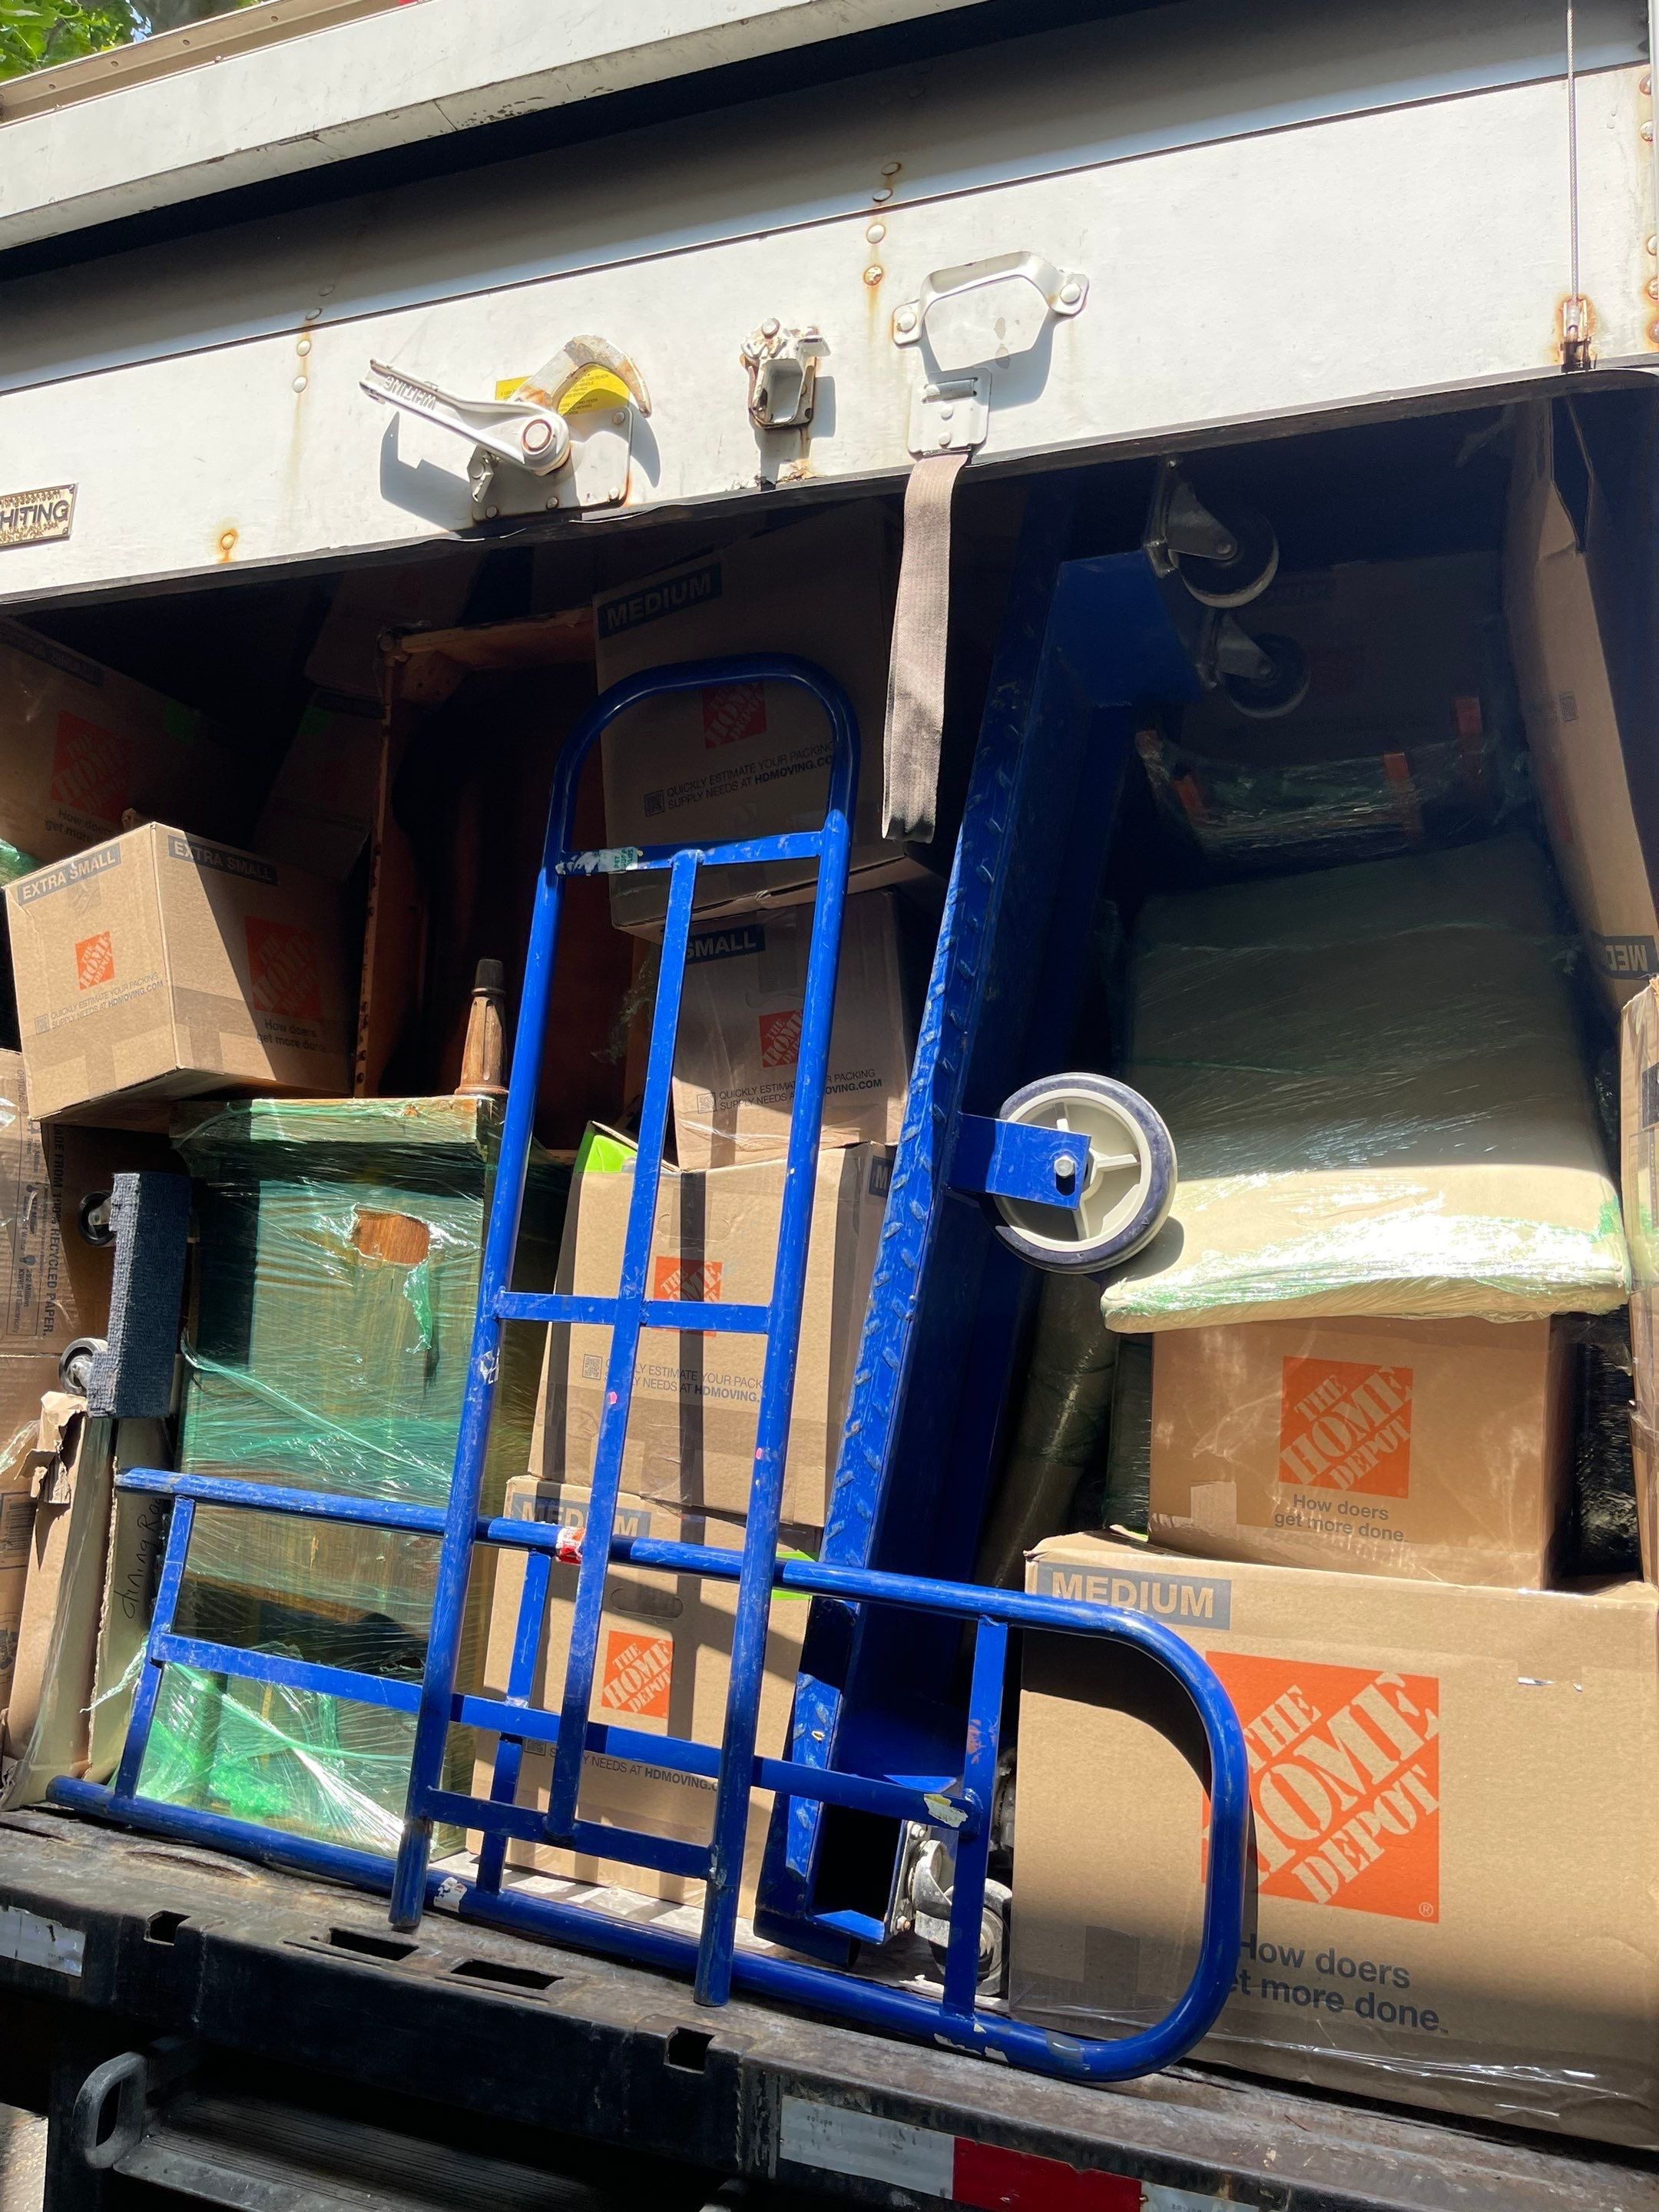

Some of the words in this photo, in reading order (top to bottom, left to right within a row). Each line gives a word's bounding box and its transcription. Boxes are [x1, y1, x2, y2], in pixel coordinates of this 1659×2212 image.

[0, 499, 69, 530] HITING
[607, 573, 711, 630] MEDIUM
[667, 777, 707, 797] QUICKLY
[709, 763, 756, 786] ESTIMATE
[758, 753, 787, 771] YOUR
[667, 792, 704, 810] SUPPLY
[706, 782, 738, 799] NEEDS
[741, 777, 753, 788] AT
[754, 755, 833, 785] HDMOVING.CO
[22, 871, 68, 901] EXTRA
[69, 850, 115, 879] SMALL
[174, 841, 223, 867] EXTRA
[227, 856, 273, 881] SMALL
[1605, 945, 1648, 972] MED
[51, 1003, 77, 1020] QUICKLY
[79, 991, 109, 1010] ESTIMATE
[111, 983, 129, 996] YOUR
[130, 972, 159, 989] PACKING
[52, 1013, 76, 1029] SUPPLY
[78, 1005, 99, 1018] NEEDS
[100, 1002, 108, 1012] AT
[108, 979, 164, 1008] HDMOVING.COM
[17, 1068, 25, 1103] OPTIONS
[720, 1086, 758, 1100] QUICKLY
[760, 1081, 796, 1094] ESTIMAT
[826, 1078, 882, 1094] OVING.COM
[834, 1068, 876, 1082] PACKING
[720, 1099, 754, 1111] SUPPLY
[757, 1094, 786, 1104] NEEDS
[53, 1154, 64, 1188] FROM
[48, 1227, 60, 1288] RECYCLED
[12, 1298, 23, 1333] Electricity
[42, 1293, 57, 1336] PAPER.
[643, 1379, 677, 1392] NEEDS
[680, 1383, 692, 1393] AT
[695, 1385, 760, 1402] HDMOVING.
[649, 1365, 697, 1382] ESTIMATE
[702, 1372, 730, 1385] YOUR
[734, 1376, 762, 1389] PACK
[1293, 1374, 1346, 1421] THE
[1280, 1366, 1413, 1484] HOME
[1329, 1416, 1411, 1491] DEPOT
[522, 1501, 638, 1537] MEDM
[1274, 1512, 1303, 1528] get
[1308, 1518, 1353, 1535] more
[1293, 1494, 1332, 1512] How
[1337, 1501, 1389, 1521] doers
[1052, 1571, 1214, 1618] MEDIUM
[602, 1639, 674, 1709] HOME
[612, 1643, 641, 1671] THE
[628, 1668, 671, 1714] DEPOT
[1244, 1684, 1321, 1773] THE
[591, 1756, 628, 1773] NEEDS
[630, 1765, 642, 1776] AT
[1291, 1765, 1439, 1904] DEPOT
[1315, 1947, 1410, 1988] doers
[1261, 1978, 1344, 2012] more
